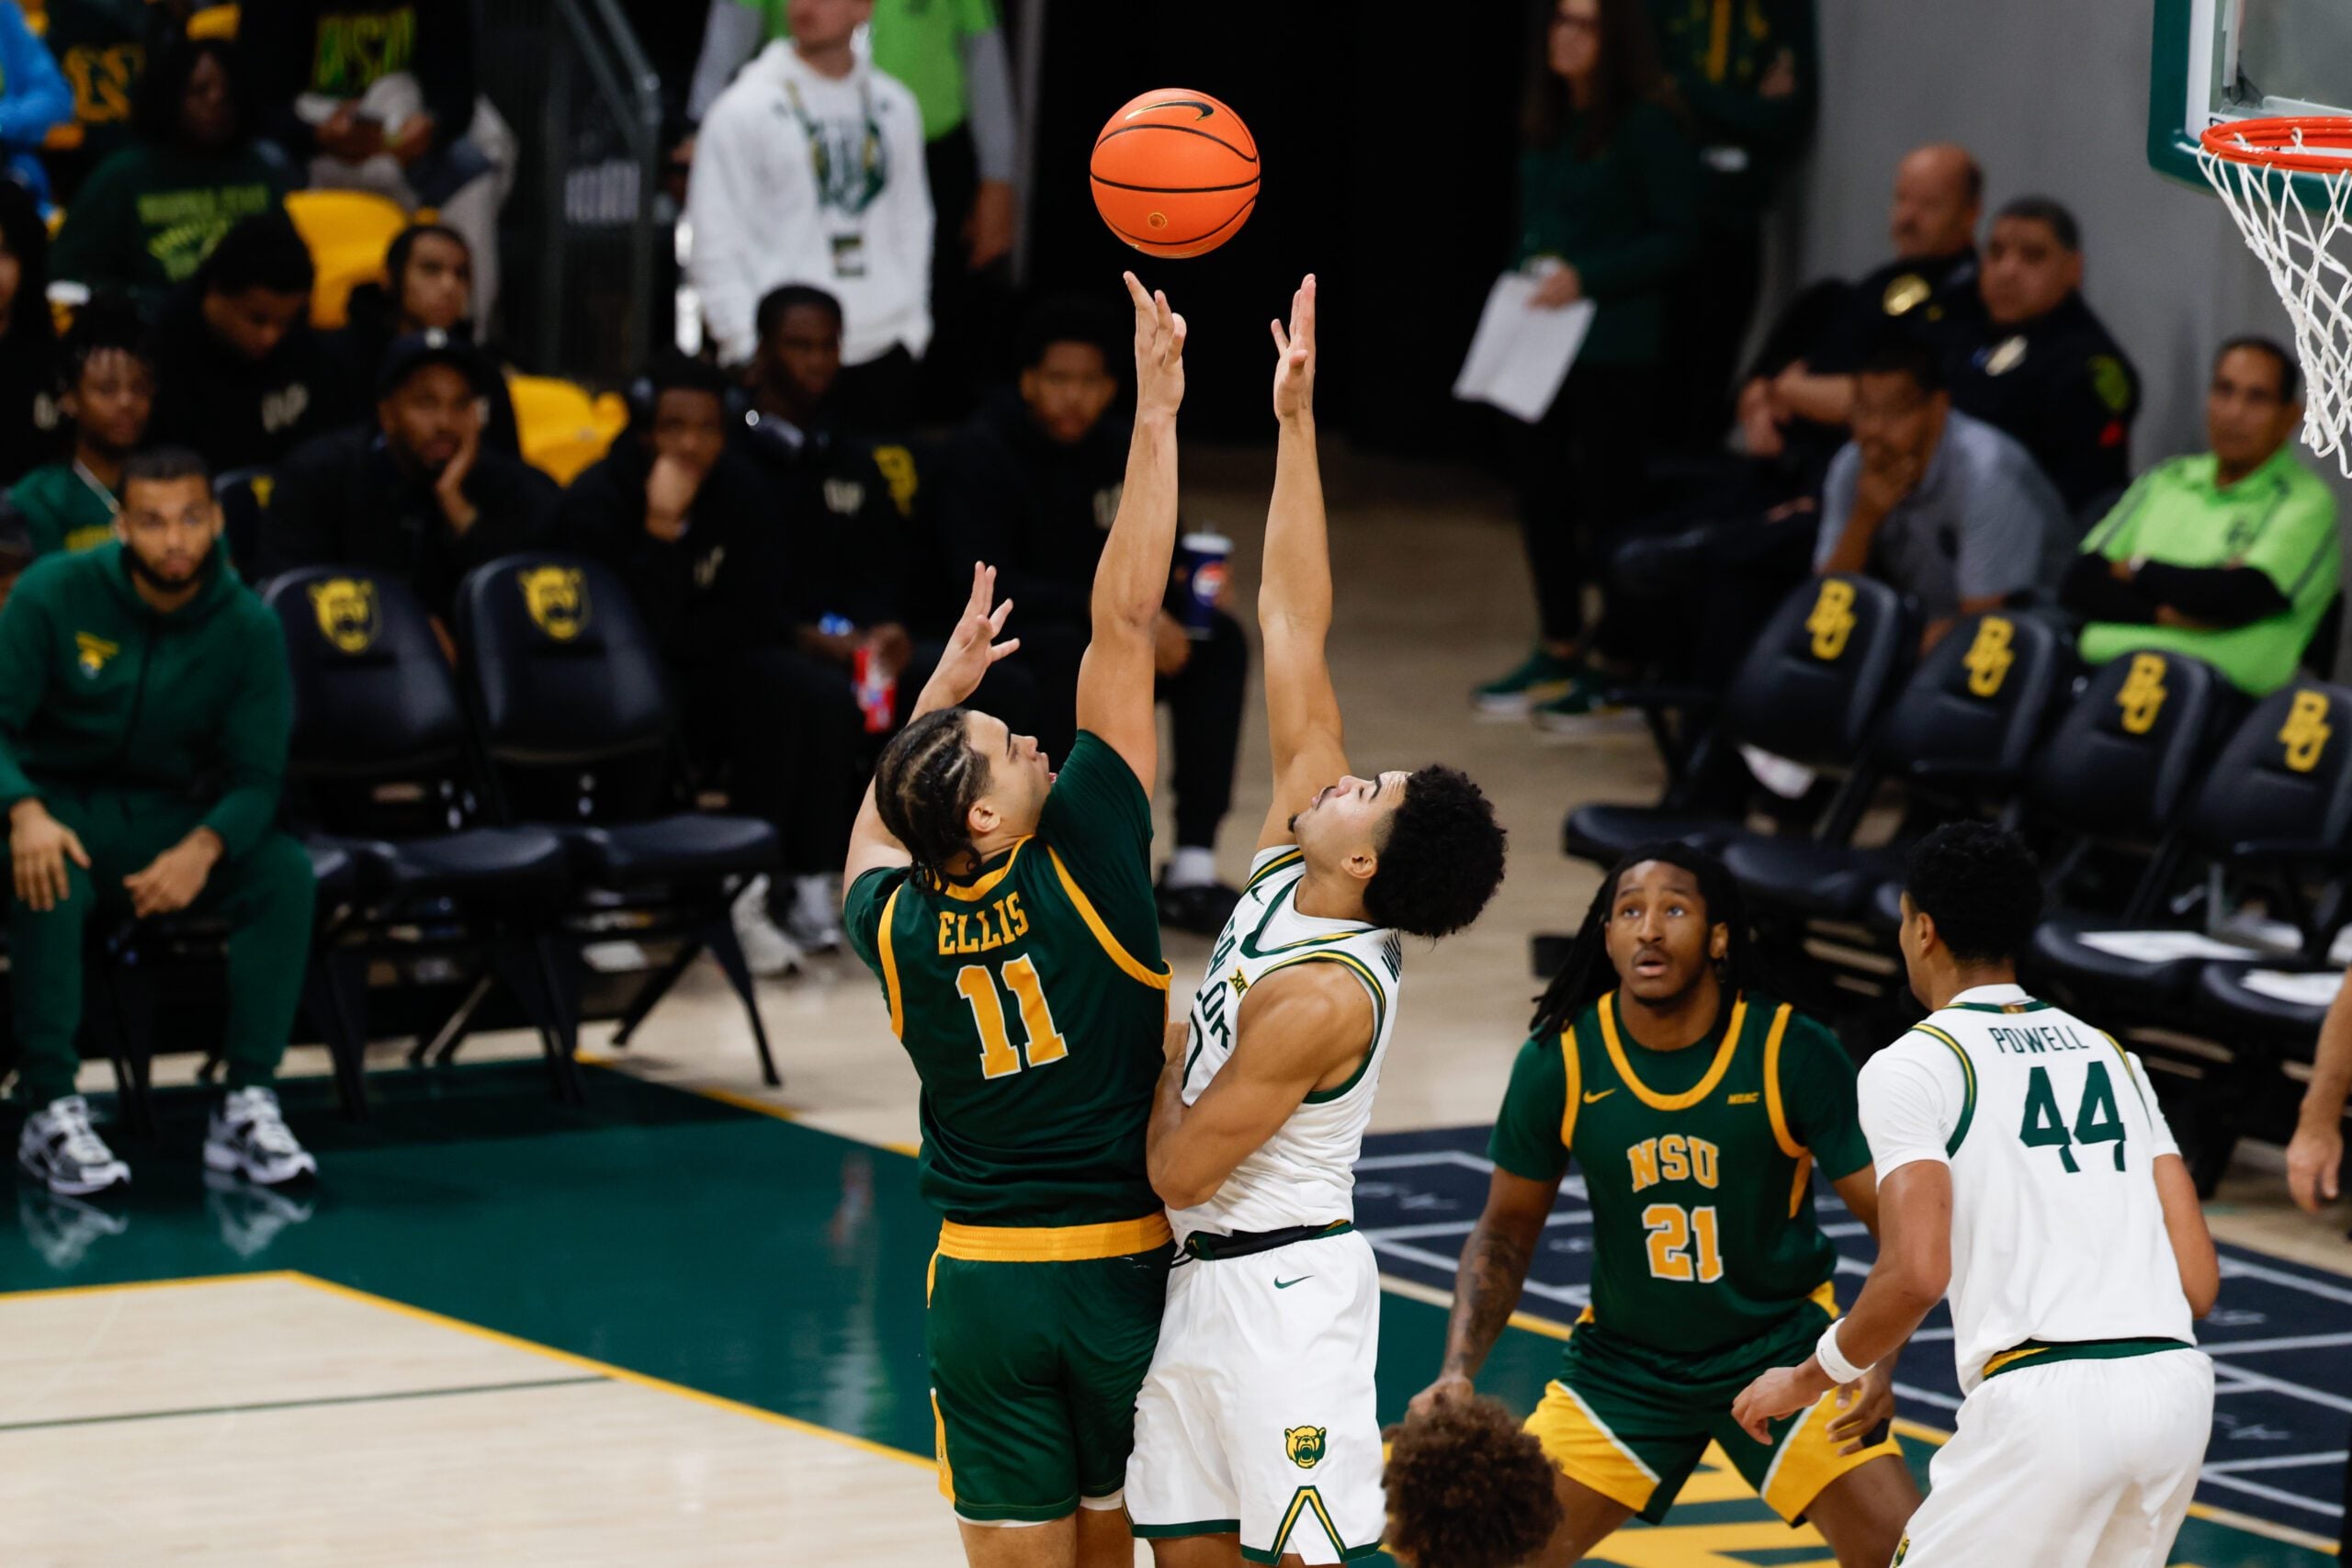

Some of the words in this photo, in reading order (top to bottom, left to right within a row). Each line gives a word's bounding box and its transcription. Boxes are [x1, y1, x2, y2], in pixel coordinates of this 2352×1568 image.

[938, 890, 1029, 955] ELLIS
[956, 953, 1069, 1079] 11
[1988, 1025, 2090, 1054] POWELL
[2018, 1060, 2127, 1174] 44
[1626, 1134, 1720, 1193] NSU
[1641, 1203, 1724, 1283] 21
